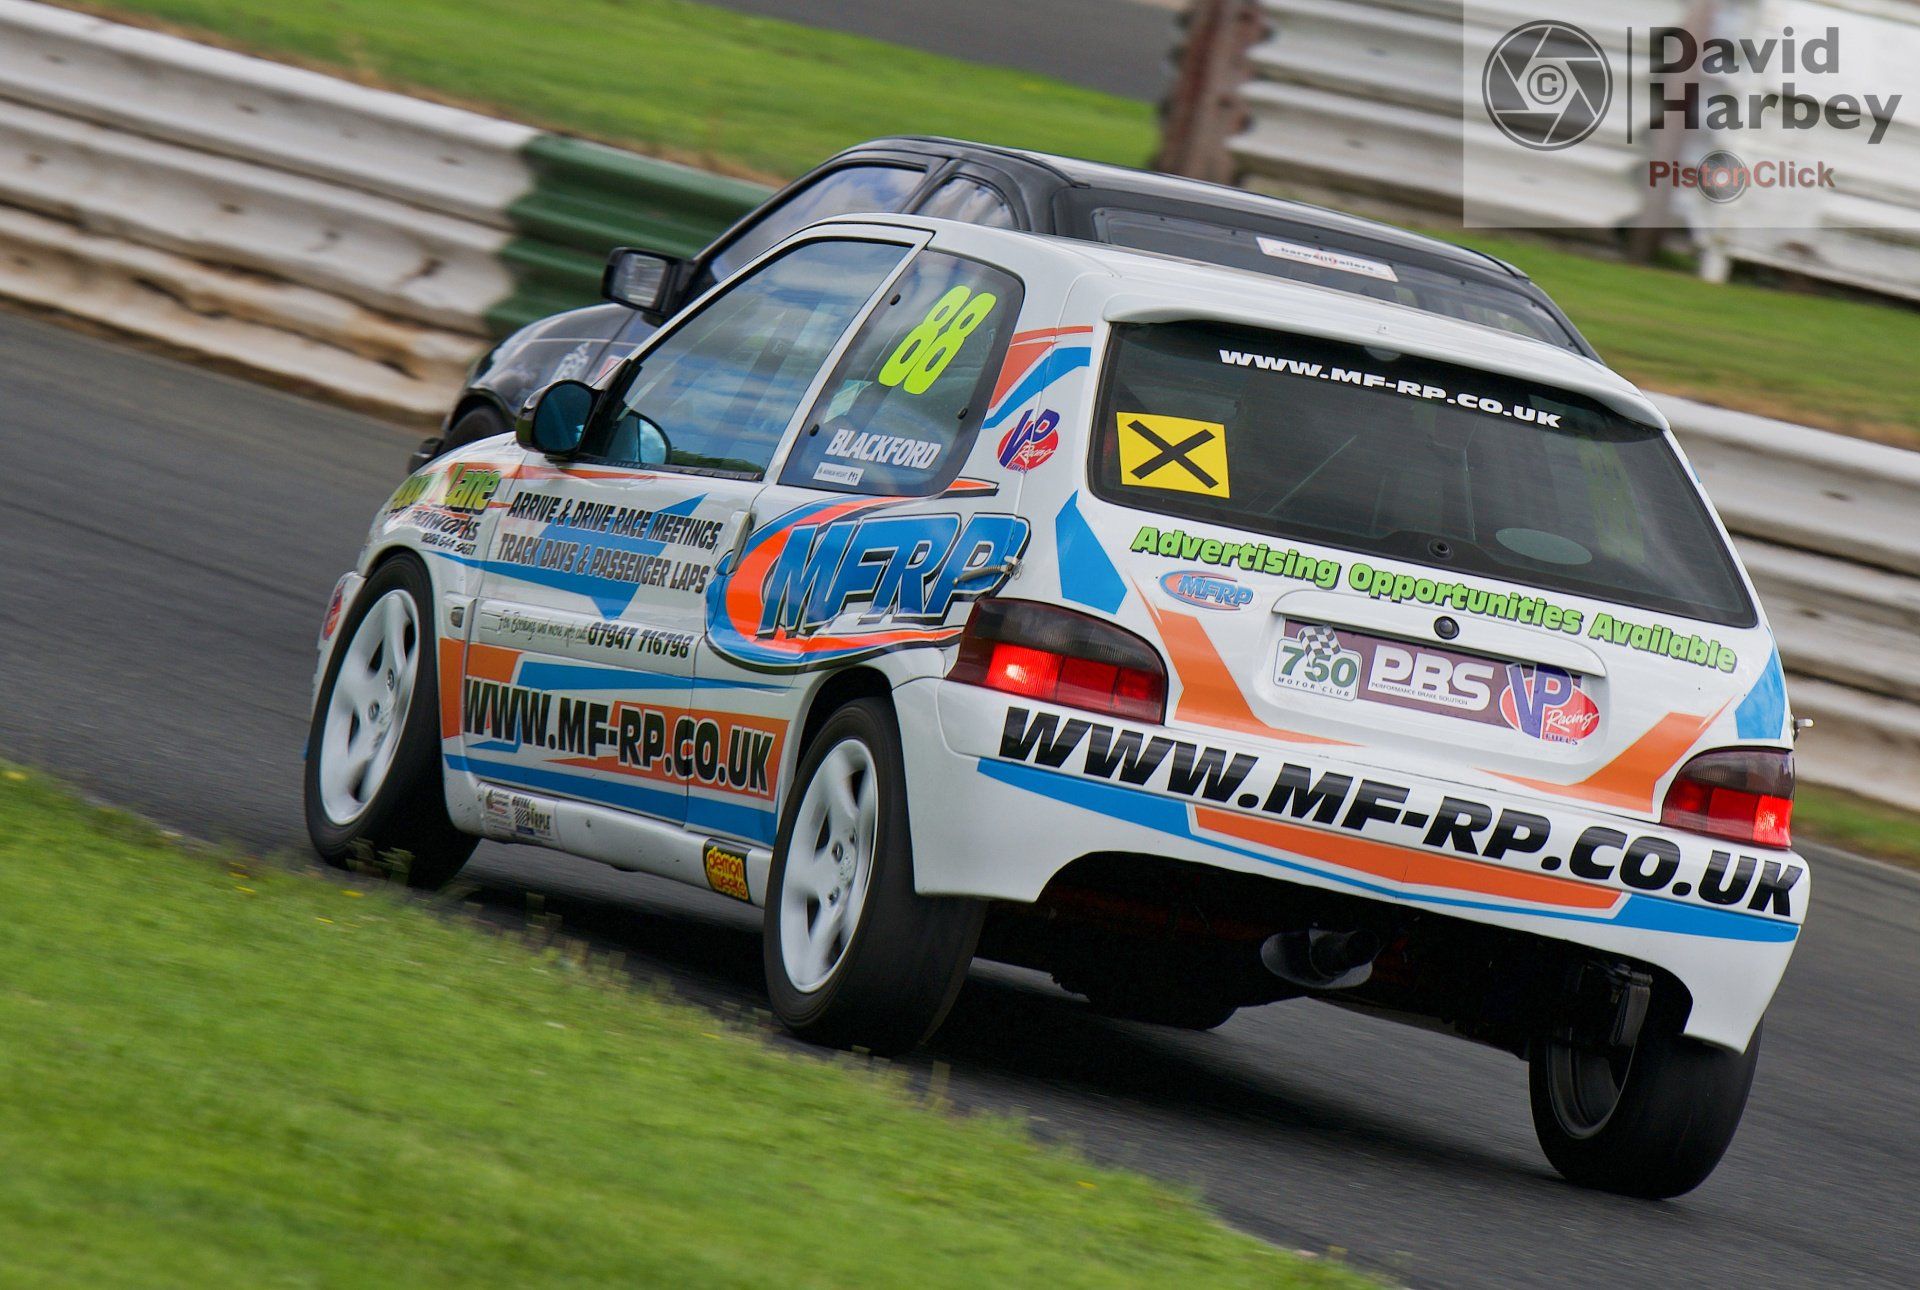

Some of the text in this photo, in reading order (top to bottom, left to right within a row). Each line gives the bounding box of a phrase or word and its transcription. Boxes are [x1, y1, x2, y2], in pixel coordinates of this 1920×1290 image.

[878, 285, 997, 395] 88
[1219, 348, 1563, 429] WWW.MF-RP.CO.UK
[825, 428, 942, 470] BLACKFORD
[998, 408, 1060, 468] VP
[445, 462, 502, 516] Lane
[506, 491, 724, 555] ARRIVE & DRIVE RACE MEETINGS,
[497, 533, 711, 594] TRACK DAYS & PASSENGER LAPS
[755, 511, 1032, 641] MFRP
[1177, 574, 1254, 607] MFRP
[1130, 525, 1738, 673] Advertising Opportunities Available
[588, 621, 639, 651] 07947
[636, 629, 695, 659] 716798
[1280, 645, 1358, 688] 750
[1277, 676, 1352, 698] MOTOR CLUB
[1367, 644, 1495, 711] PBS
[1370, 681, 1416, 697] PERFORMANCE
[1504, 662, 1575, 740] VP
[465, 675, 777, 796] WWW.MF-RP.CO.UK
[1545, 706, 1601, 733] Racing
[1545, 732, 1579, 746] FUELS
[999, 707, 1803, 917] WWW.MF-RP.CO.UK
